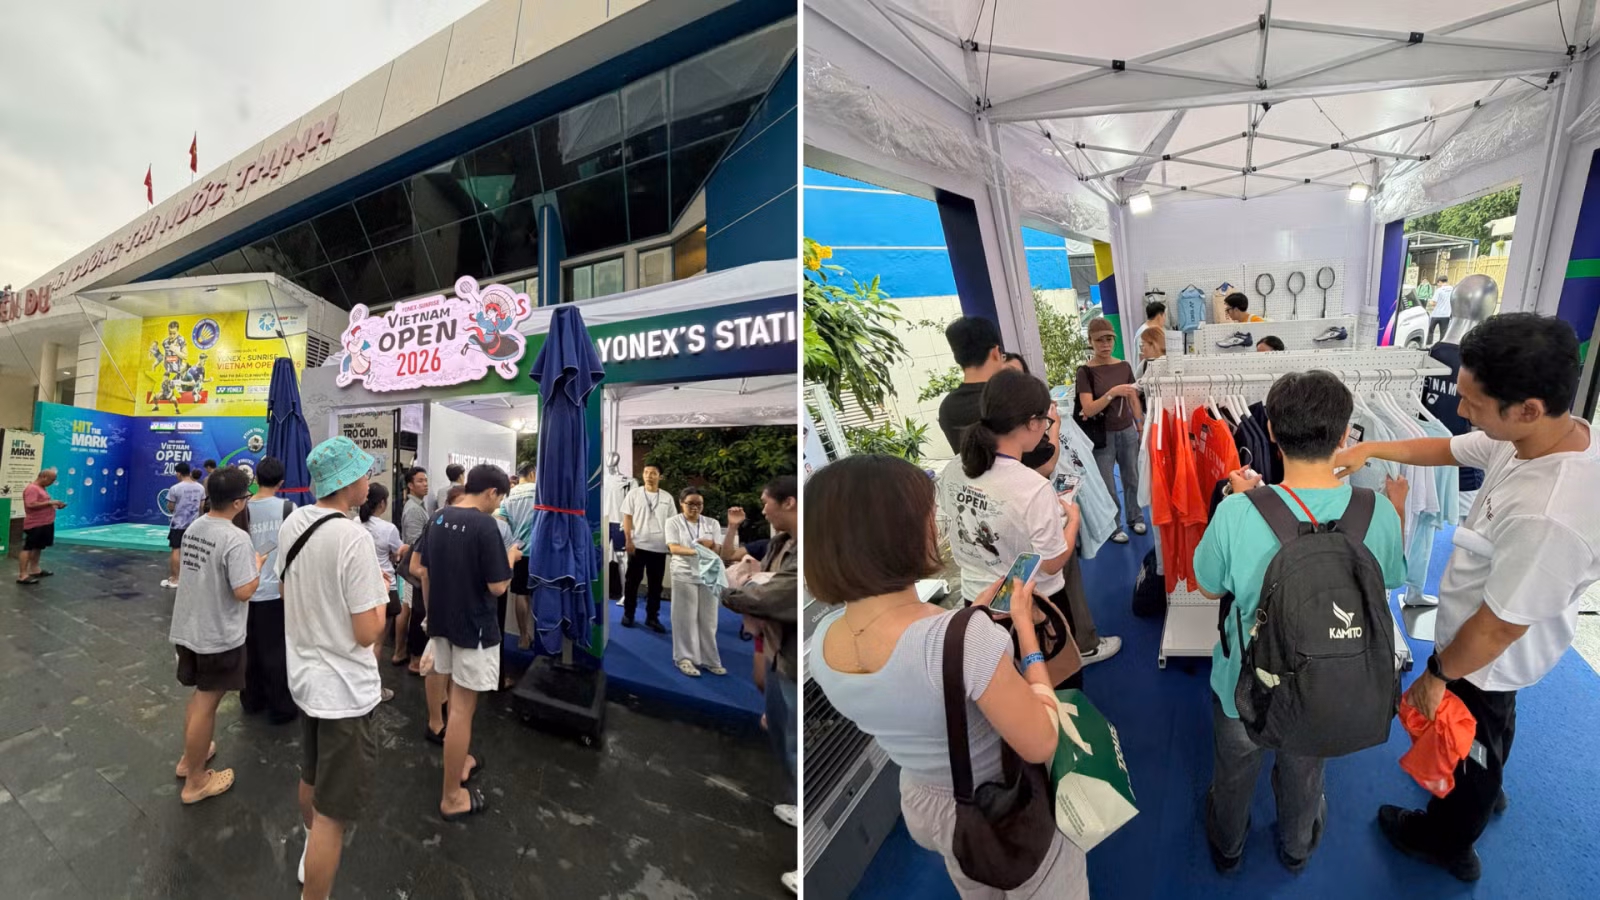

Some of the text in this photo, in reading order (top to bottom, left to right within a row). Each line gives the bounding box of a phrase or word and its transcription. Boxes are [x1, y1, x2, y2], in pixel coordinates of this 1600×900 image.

[387, 307, 451, 329] VIETNAM
[379, 318, 458, 352] OPEN
[715, 311, 797, 349] STATI
[217, 361, 253, 370] VIETNAM
[397, 347, 441, 377] 2026
[73, 419, 93, 433] HIT
[12, 440, 25, 448] HIT
[71, 433, 108, 448] MARK
[161, 442, 190, 450] VIETNAM
[10, 448, 35, 457] MARK
[156, 450, 192, 462] OPEN
[956, 492, 988, 511] OPEN
[1329, 626, 1362, 639] KAMITO
